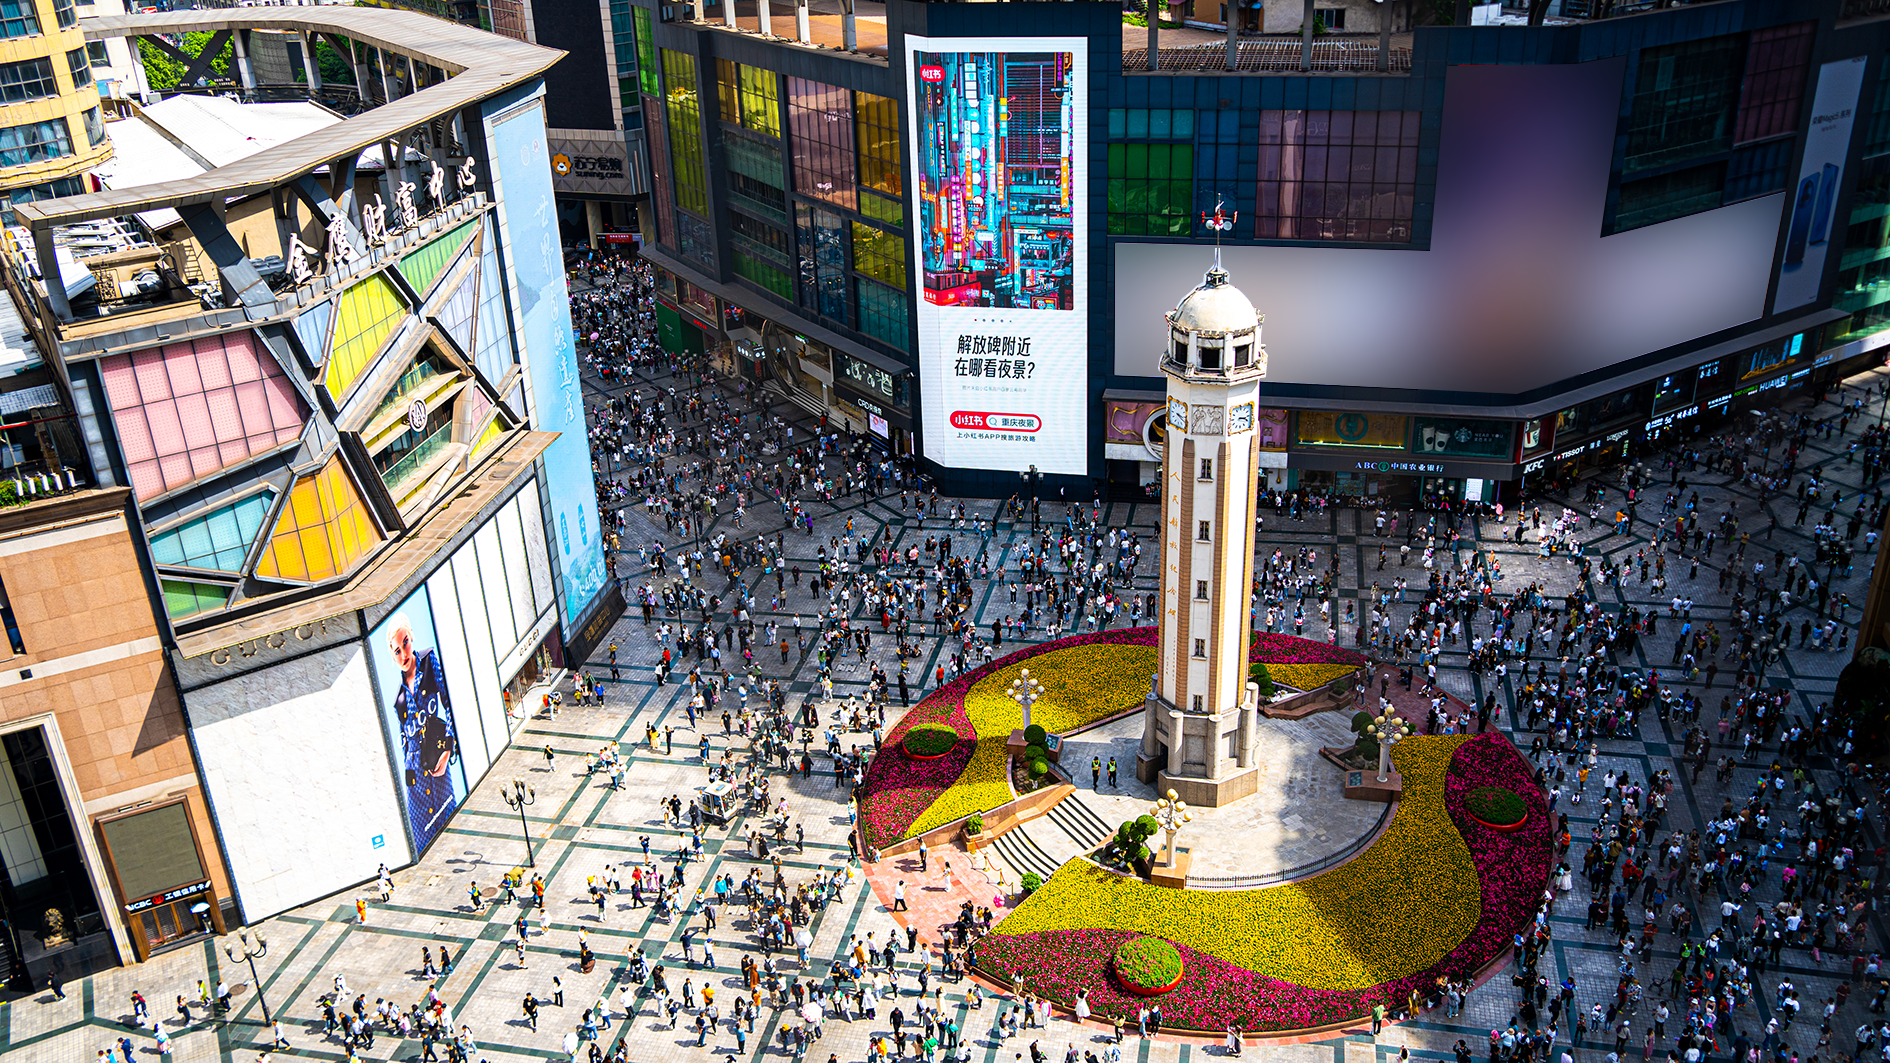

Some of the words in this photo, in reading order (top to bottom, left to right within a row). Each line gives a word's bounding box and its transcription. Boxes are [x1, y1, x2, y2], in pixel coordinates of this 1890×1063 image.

[921, 68, 942, 80] 小红书
[574, 156, 622, 172] 苏宁易购
[575, 170, 624, 180] suning.com
[286, 156, 477, 285] 金鹰财富中心
[957, 334, 1031, 357] 解放碑附近
[1758, 374, 1788, 392] HUAWEI
[954, 414, 984, 426] 小红书
[1001, 418, 1035, 428] 重庆夜景
[1561, 445, 1585, 459] TISSOT
[1355, 461, 1378, 470] ABC
[1391, 462, 1444, 473] 中国农业银行
[1523, 459, 1545, 474] KFC
[210, 619, 327, 666] GUCCI
[519, 628, 540, 657] GUCCI
[164, 883, 205, 901] 工银信用卡
